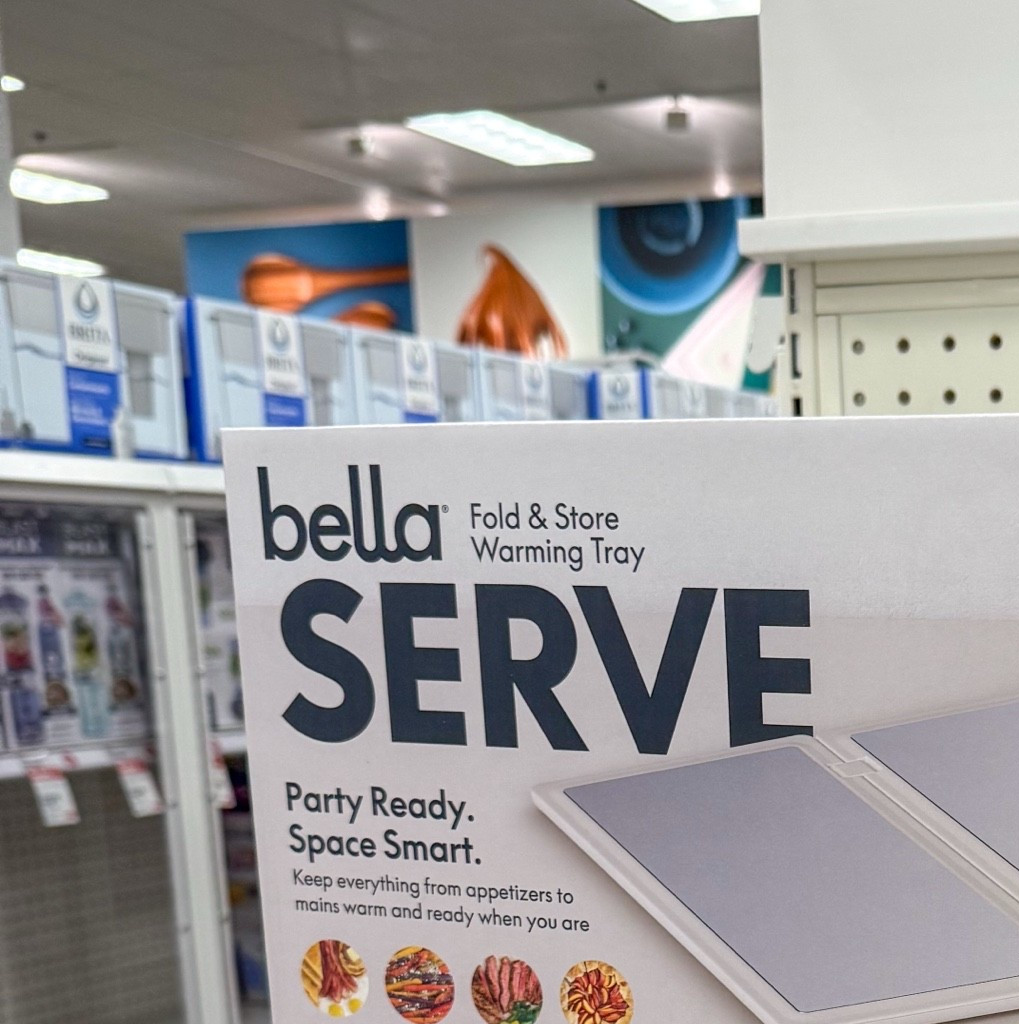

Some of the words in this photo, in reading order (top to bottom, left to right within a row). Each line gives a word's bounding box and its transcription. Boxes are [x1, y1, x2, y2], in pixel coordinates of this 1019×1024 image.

[257, 465, 443, 563] bella
[470, 503, 520, 531] Fold
[528, 505, 548, 531] &
[554, 504, 619, 531] Store
[471, 537, 583, 572] Warming
[590, 538, 645, 572] Tray
[280, 578, 813, 755] SERVE
[285, 782, 363, 824] Party
[371, 787, 475, 830] Ready.
[289, 824, 377, 863] Space
[384, 829, 482, 865] Smart.
[293, 869, 334, 892] Keep
[337, 875, 420, 898] everything
[424, 878, 461, 896] from
[466, 884, 553, 904] appetizers
[556, 888, 574, 904] to
[295, 899, 340, 914] mains
[344, 903, 387, 918] warm
[391, 902, 423, 920] and
[427, 907, 474, 928] ready
[478, 909, 522, 928] when
[527, 916, 557, 932] you
[561, 918, 590, 932] are
